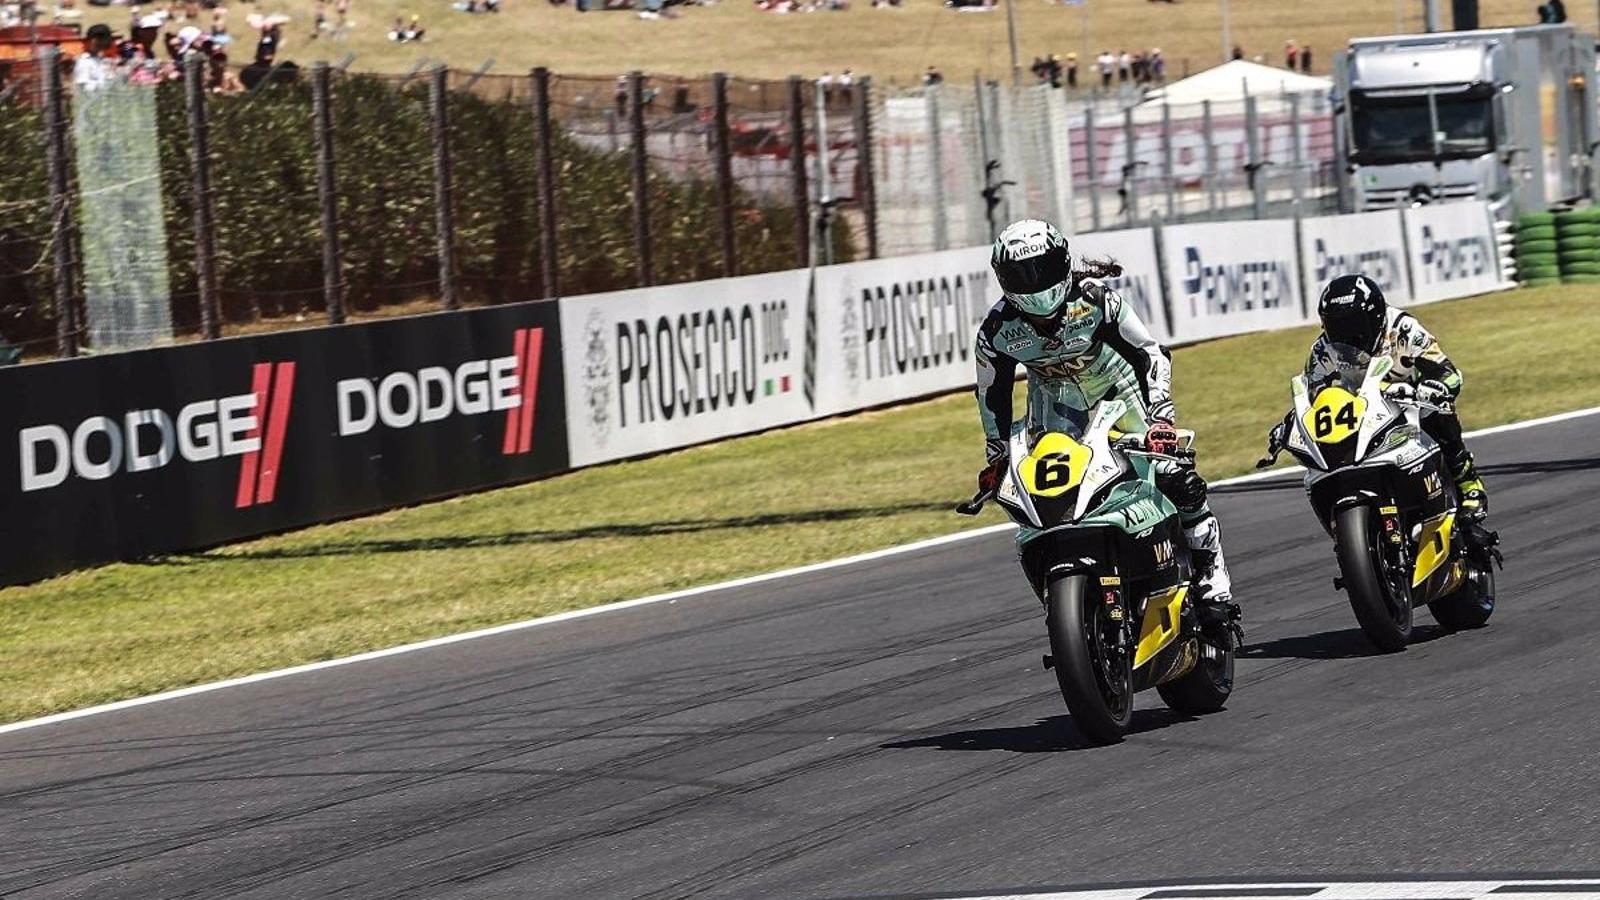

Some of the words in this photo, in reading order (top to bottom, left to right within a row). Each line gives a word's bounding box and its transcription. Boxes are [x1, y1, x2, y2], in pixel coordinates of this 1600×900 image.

[1012, 242, 1047, 259] AIROH
[1184, 246, 1293, 317] PROMETEON
[616, 303, 758, 427] PROSECCO
[862, 274, 969, 380] PROSECCO
[337, 355, 522, 436] DODGE
[1314, 401, 1358, 438] 64
[19, 392, 262, 493] DODGE
[1034, 452, 1070, 491] 6
